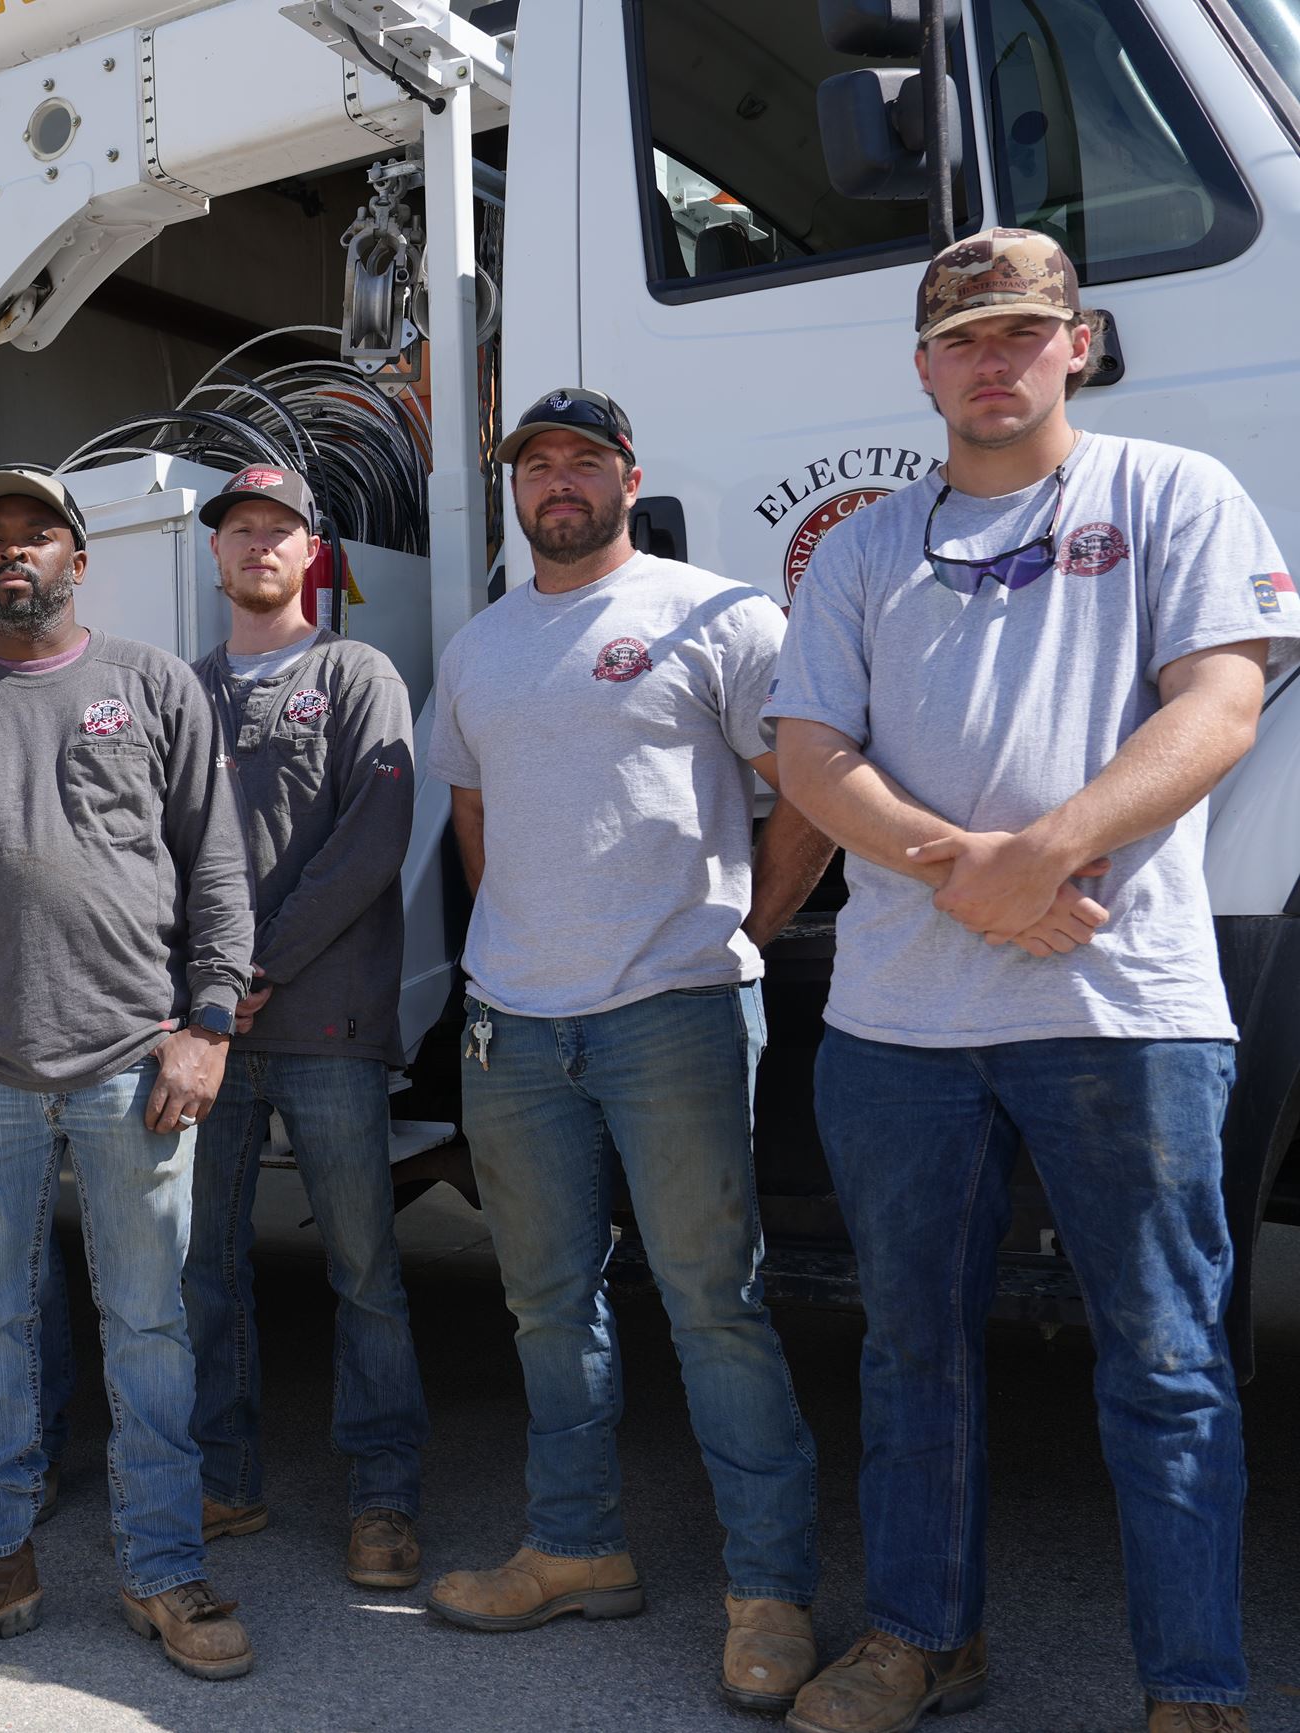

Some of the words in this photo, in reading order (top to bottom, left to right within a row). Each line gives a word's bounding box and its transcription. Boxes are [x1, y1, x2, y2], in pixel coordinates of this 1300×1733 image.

[753, 447, 944, 529] ELECTRI
[791, 530, 818, 585] ORTH
[598, 659, 649, 677] CLAYTON
[288, 703, 328, 720] CLAYTON
[86, 713, 129, 732] CLAYTON
